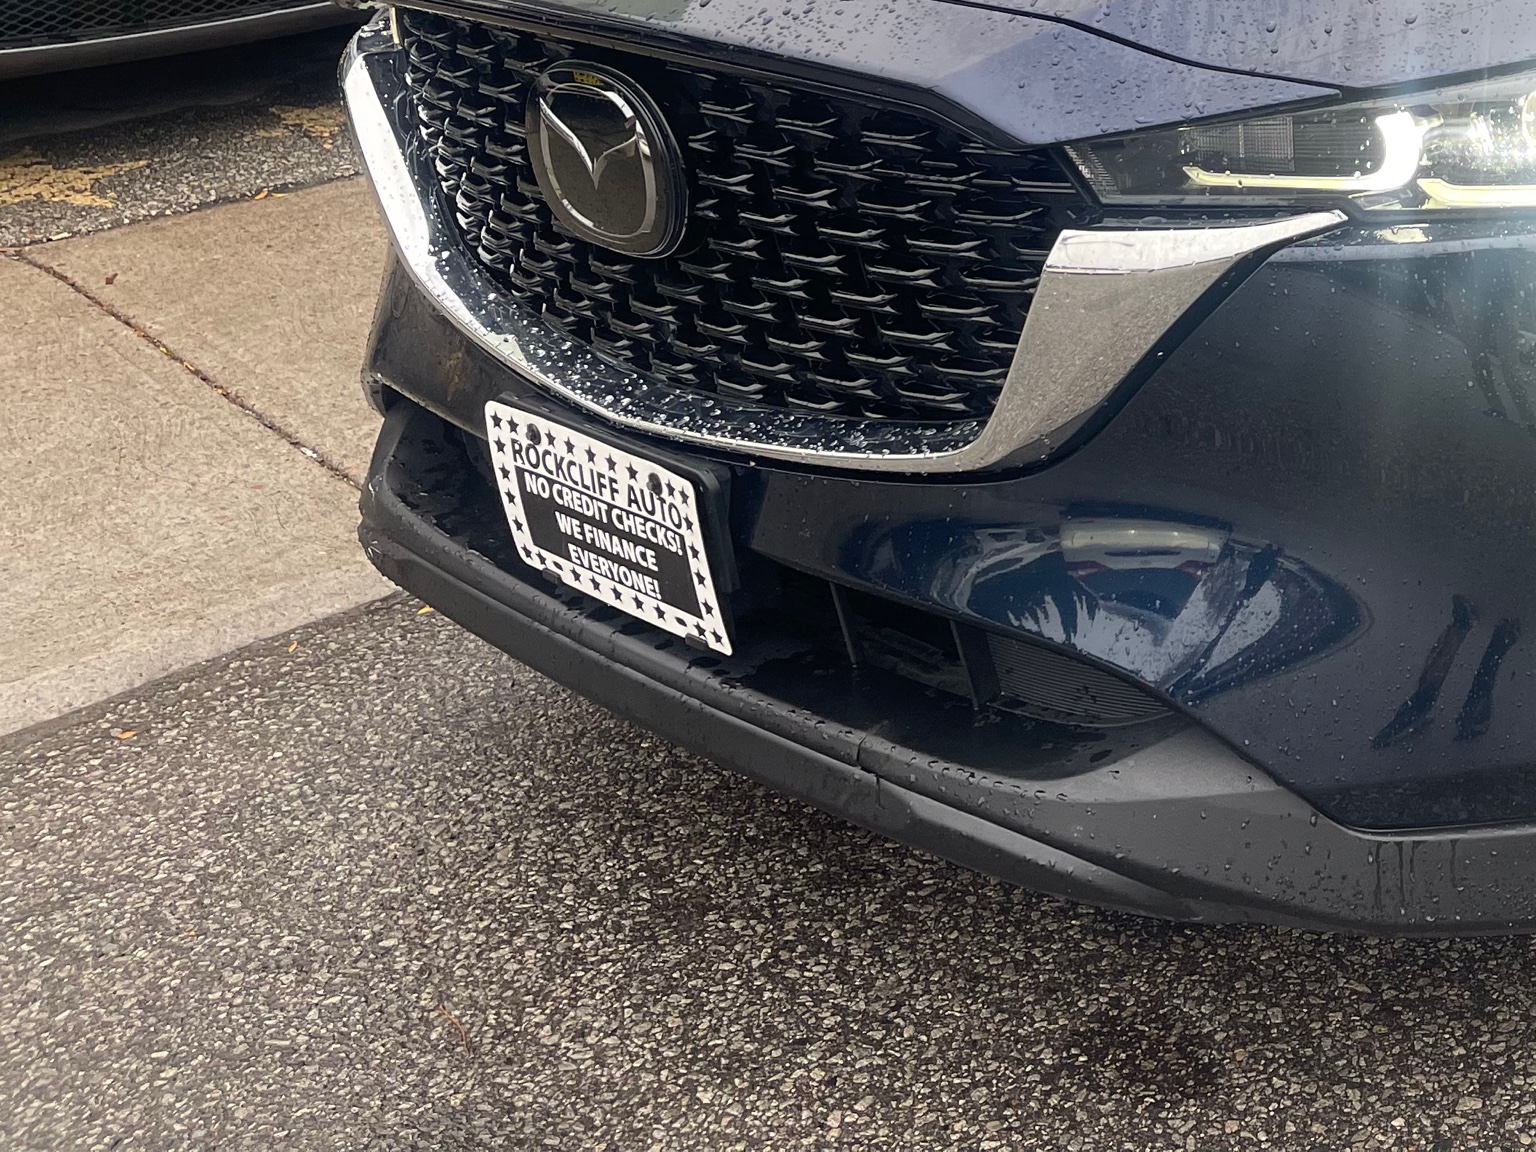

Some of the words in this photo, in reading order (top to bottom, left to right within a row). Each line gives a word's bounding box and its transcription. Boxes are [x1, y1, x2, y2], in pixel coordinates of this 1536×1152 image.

[511, 437, 620, 503] ROCKCLIFF
[626, 483, 683, 530] AUTO
[523, 471, 550, 499] NO
[552, 484, 609, 524] CREDIT
[611, 508, 683, 556] CHECKS!
[555, 511, 583, 539] WE
[585, 524, 659, 572] FINANCE
[567, 543, 662, 600] EVERYONE!
